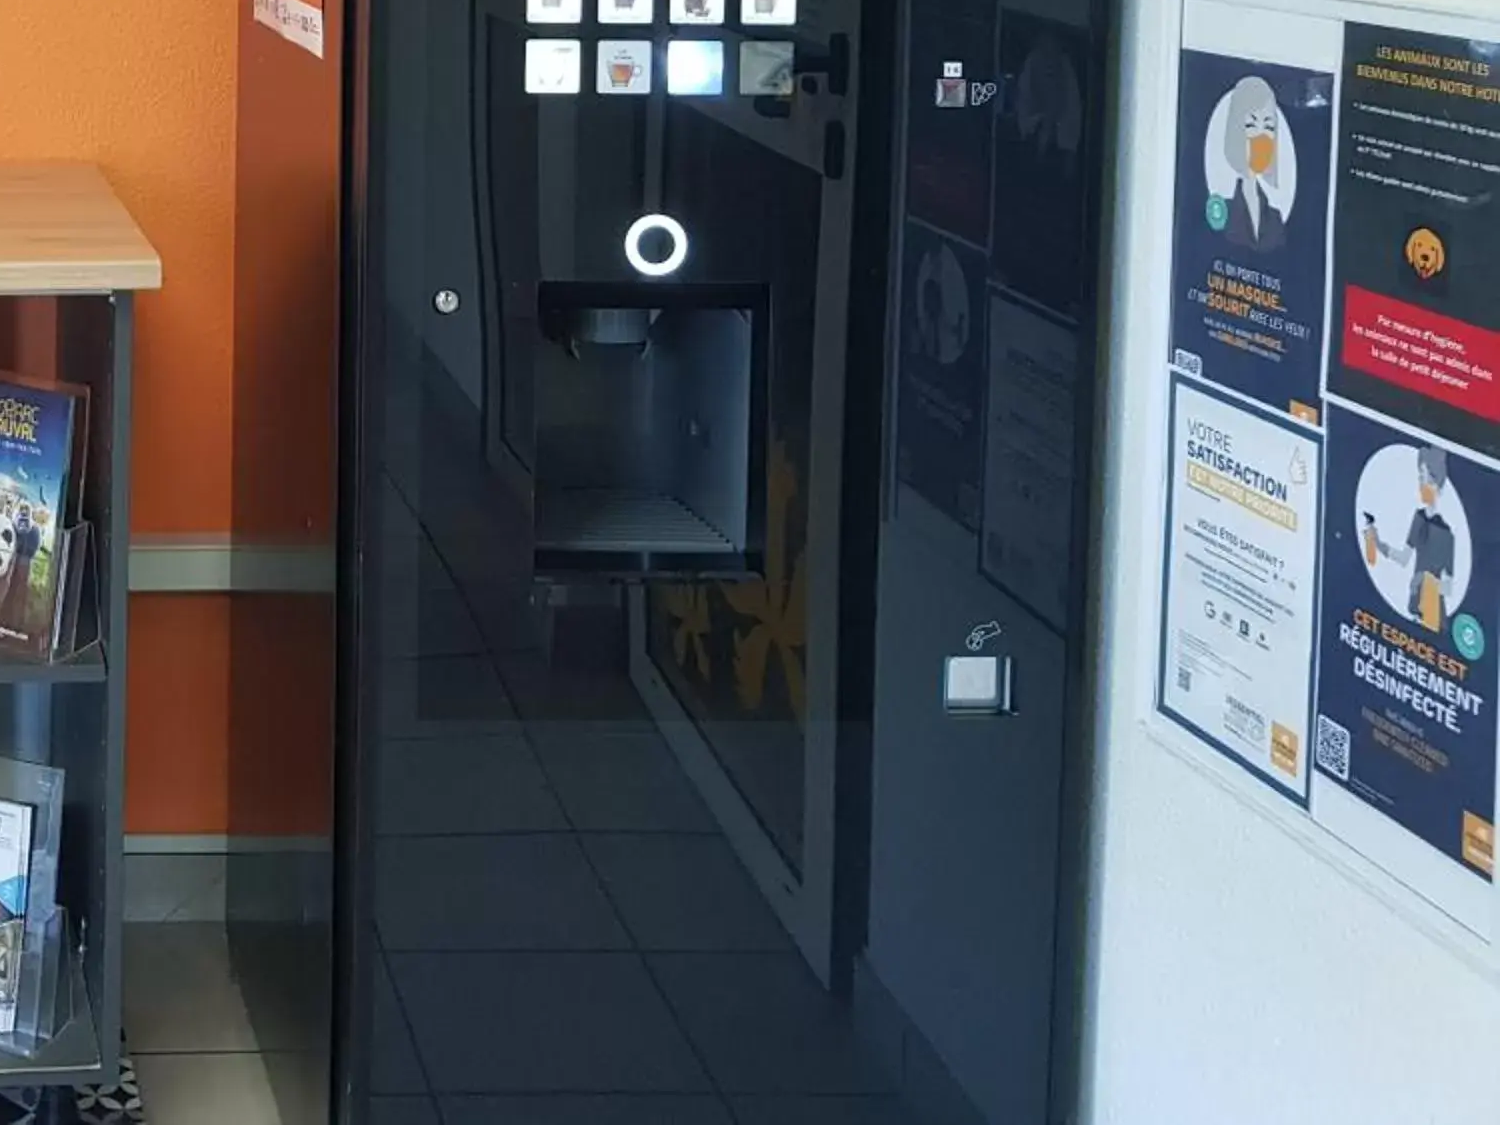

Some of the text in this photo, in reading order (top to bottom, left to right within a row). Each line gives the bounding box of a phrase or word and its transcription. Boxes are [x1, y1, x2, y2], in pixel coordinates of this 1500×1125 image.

[1376, 46, 1490, 77] LES ANIMAUX SONT LES
[1410, 74, 1438, 91] DANS
[1439, 80, 1474, 97] NOTRE
[1207, 272, 1224, 291] UN
[1207, 291, 1251, 318] SOURIT
[1378, 315, 1392, 327] Par
[1352, 322, 1364, 335] les
[1364, 328, 1398, 347] animaux
[1409, 343, 1428, 359] sont
[1428, 351, 1444, 364] pas
[1445, 356, 1471, 374] admis
[1471, 364, 1492, 381] dans
[1379, 350, 1398, 364] salle
[1398, 356, 1409, 368] de
[1410, 362, 1430, 376] petit
[1187, 417, 1233, 453] VOTRE
[1187, 440, 1287, 502] SATISFACTION
[1353, 608, 1469, 682] CET ESPACE EST
[1339, 621, 1484, 716] RÉGULIÈREMENT
[1353, 655, 1462, 735] DÉSINFECTÉ.
